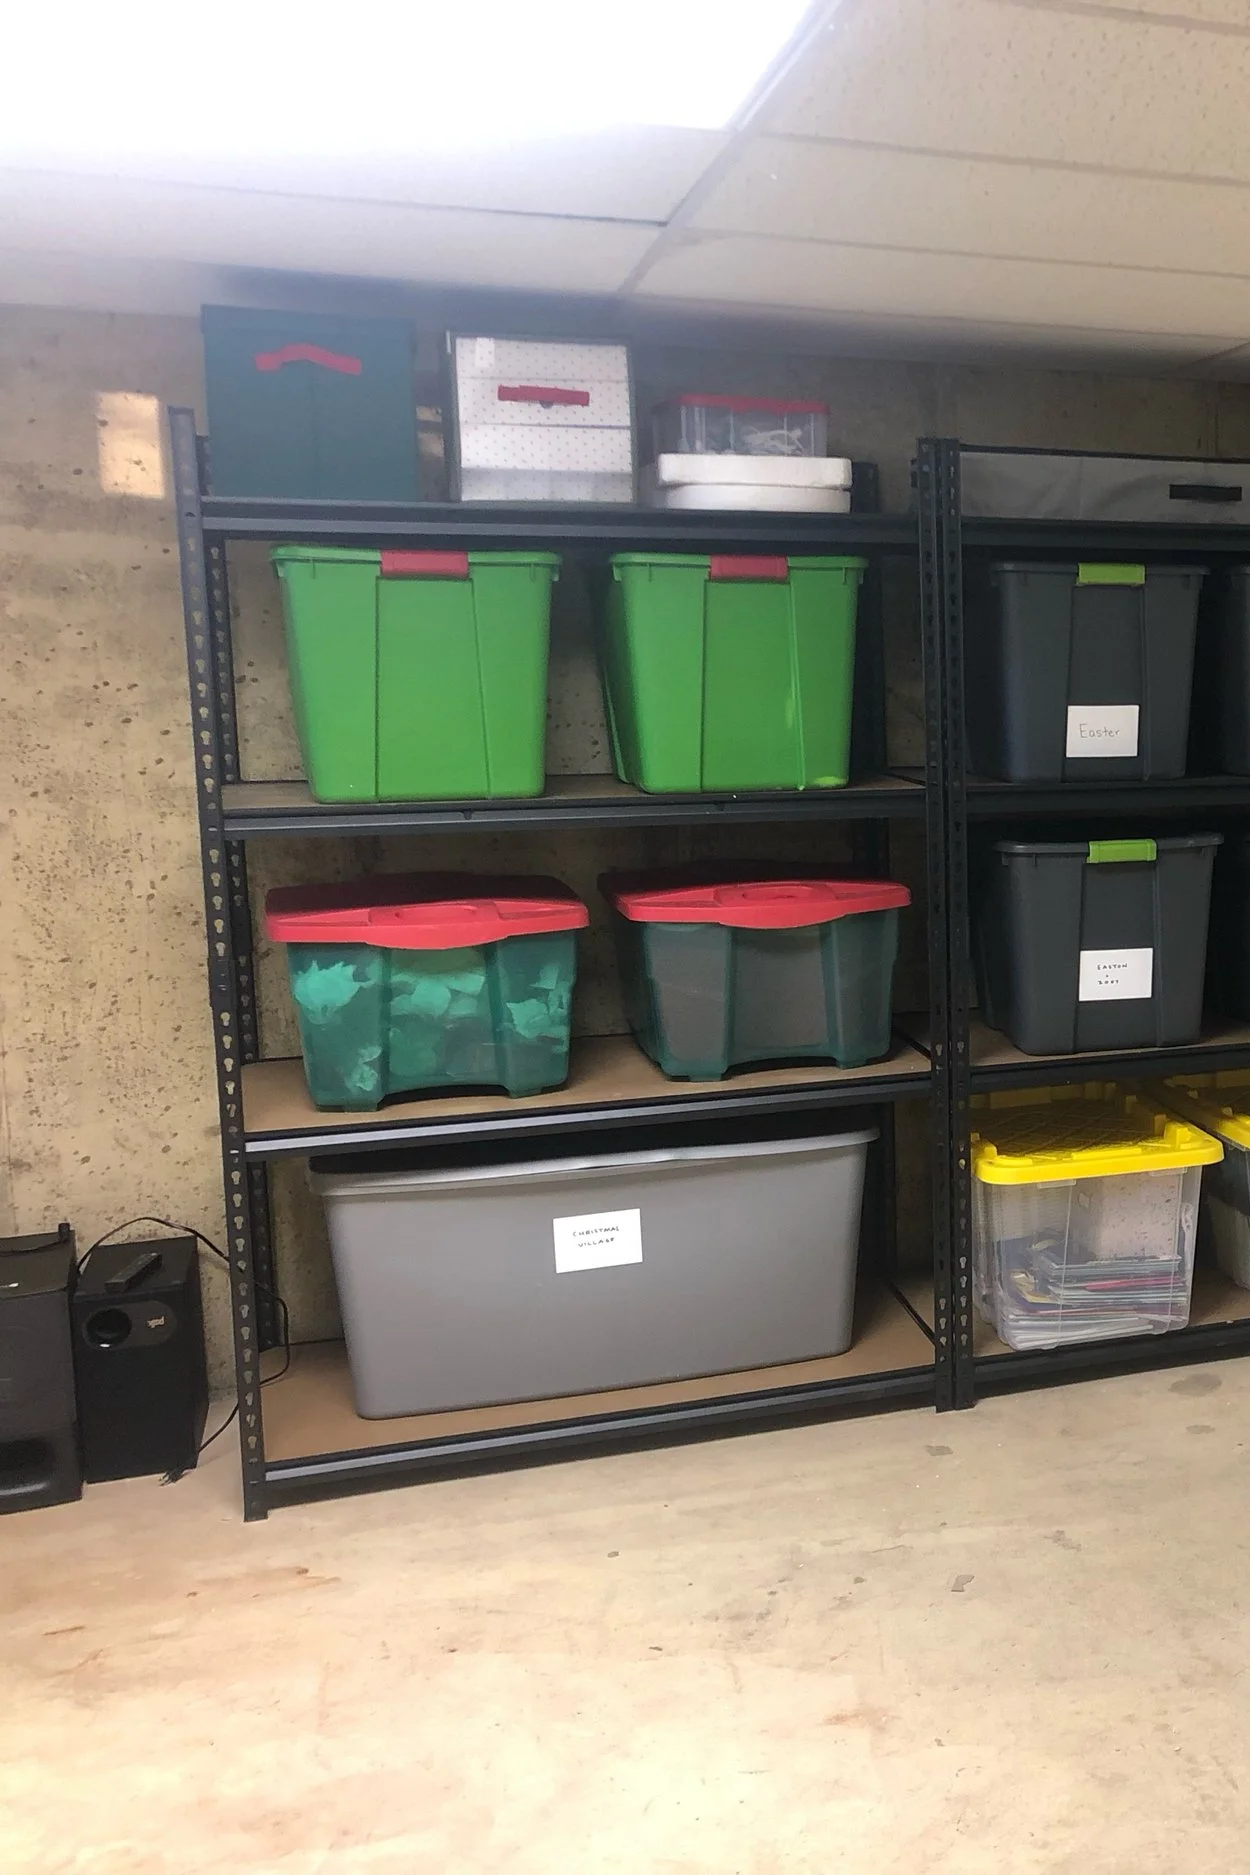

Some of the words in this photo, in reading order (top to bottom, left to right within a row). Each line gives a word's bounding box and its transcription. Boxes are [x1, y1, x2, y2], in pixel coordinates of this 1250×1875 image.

[1079, 723, 1120, 738] Easter
[1097, 963, 1128, 971] EASTON
[572, 1226, 620, 1237] CHRISTMAS
[578, 1237, 615, 1248] VILLAGE
